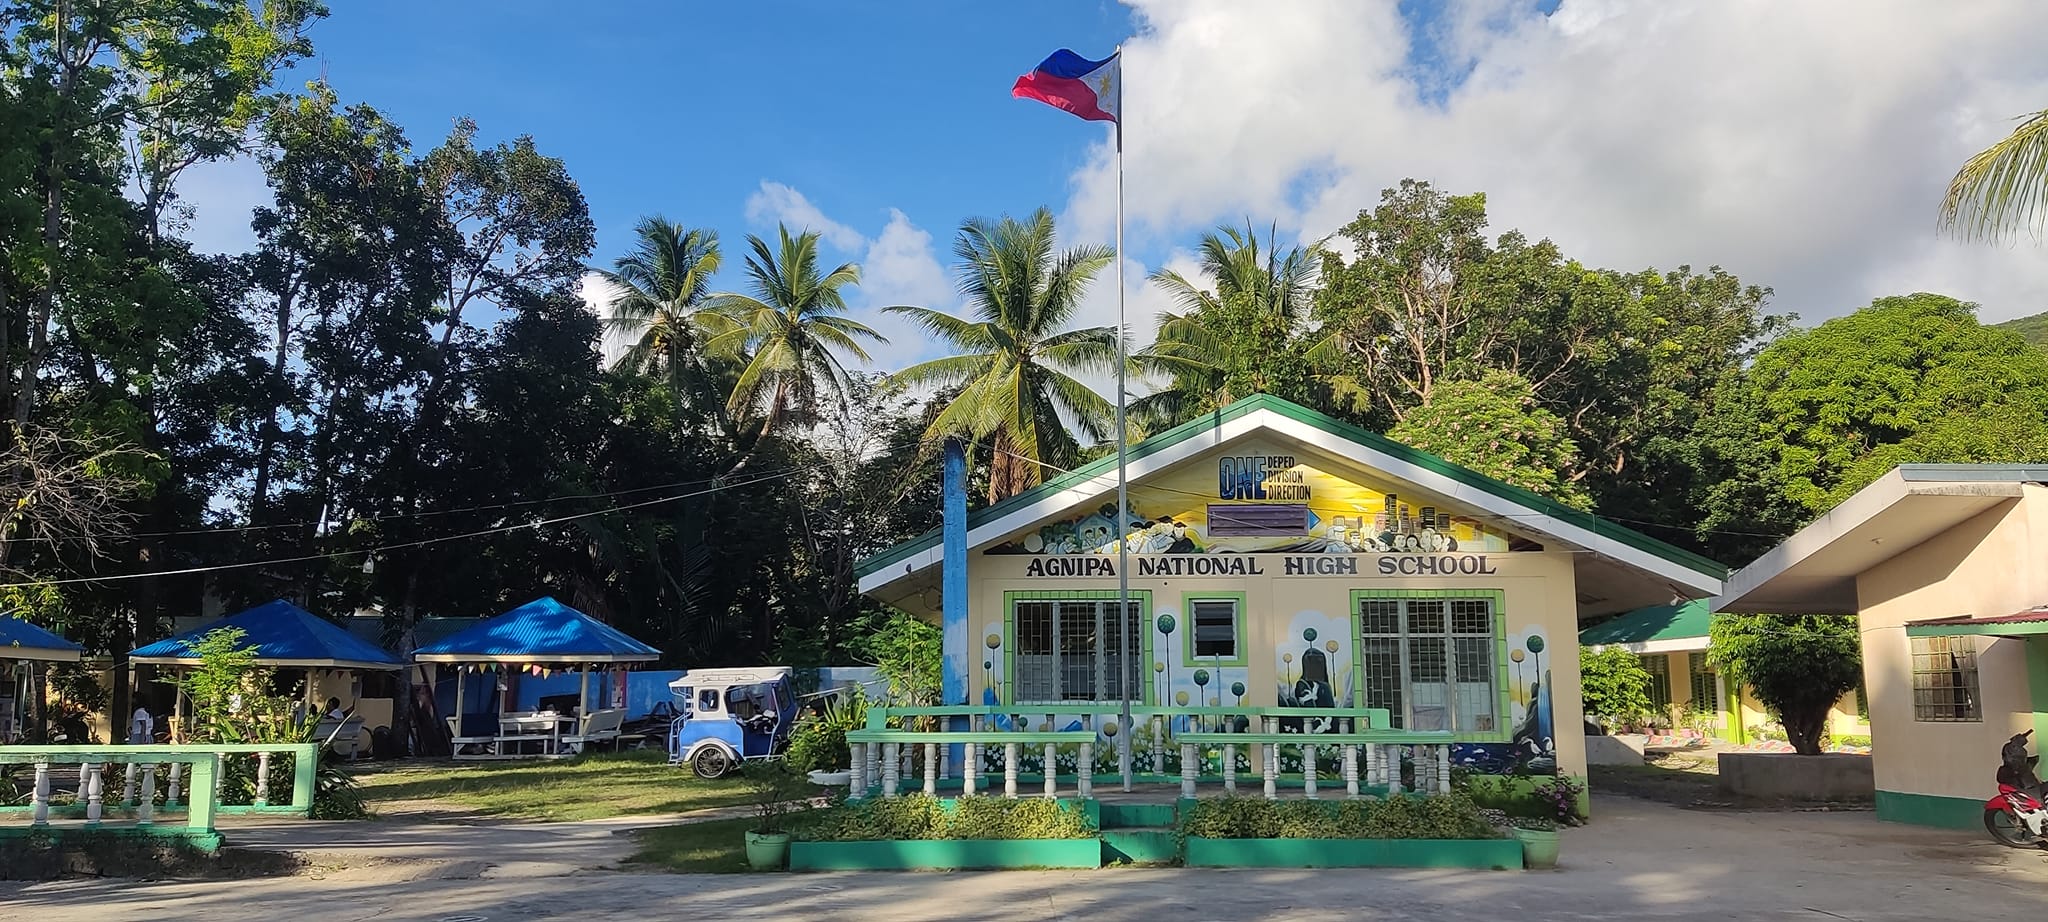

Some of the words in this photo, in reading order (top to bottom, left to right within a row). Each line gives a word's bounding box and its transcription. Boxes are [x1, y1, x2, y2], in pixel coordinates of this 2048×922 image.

[1267, 456, 1295, 468] DEPED
[1219, 456, 1267, 500] ONE
[1267, 470, 1303, 483] DIVISION
[1268, 485, 1311, 500] DIRECTION
[1026, 558, 1116, 576] AGNIPA
[1138, 557, 1264, 576] NATIONAL
[1284, 556, 1358, 576] HIGH
[1377, 555, 1497, 576] SCHOOL
